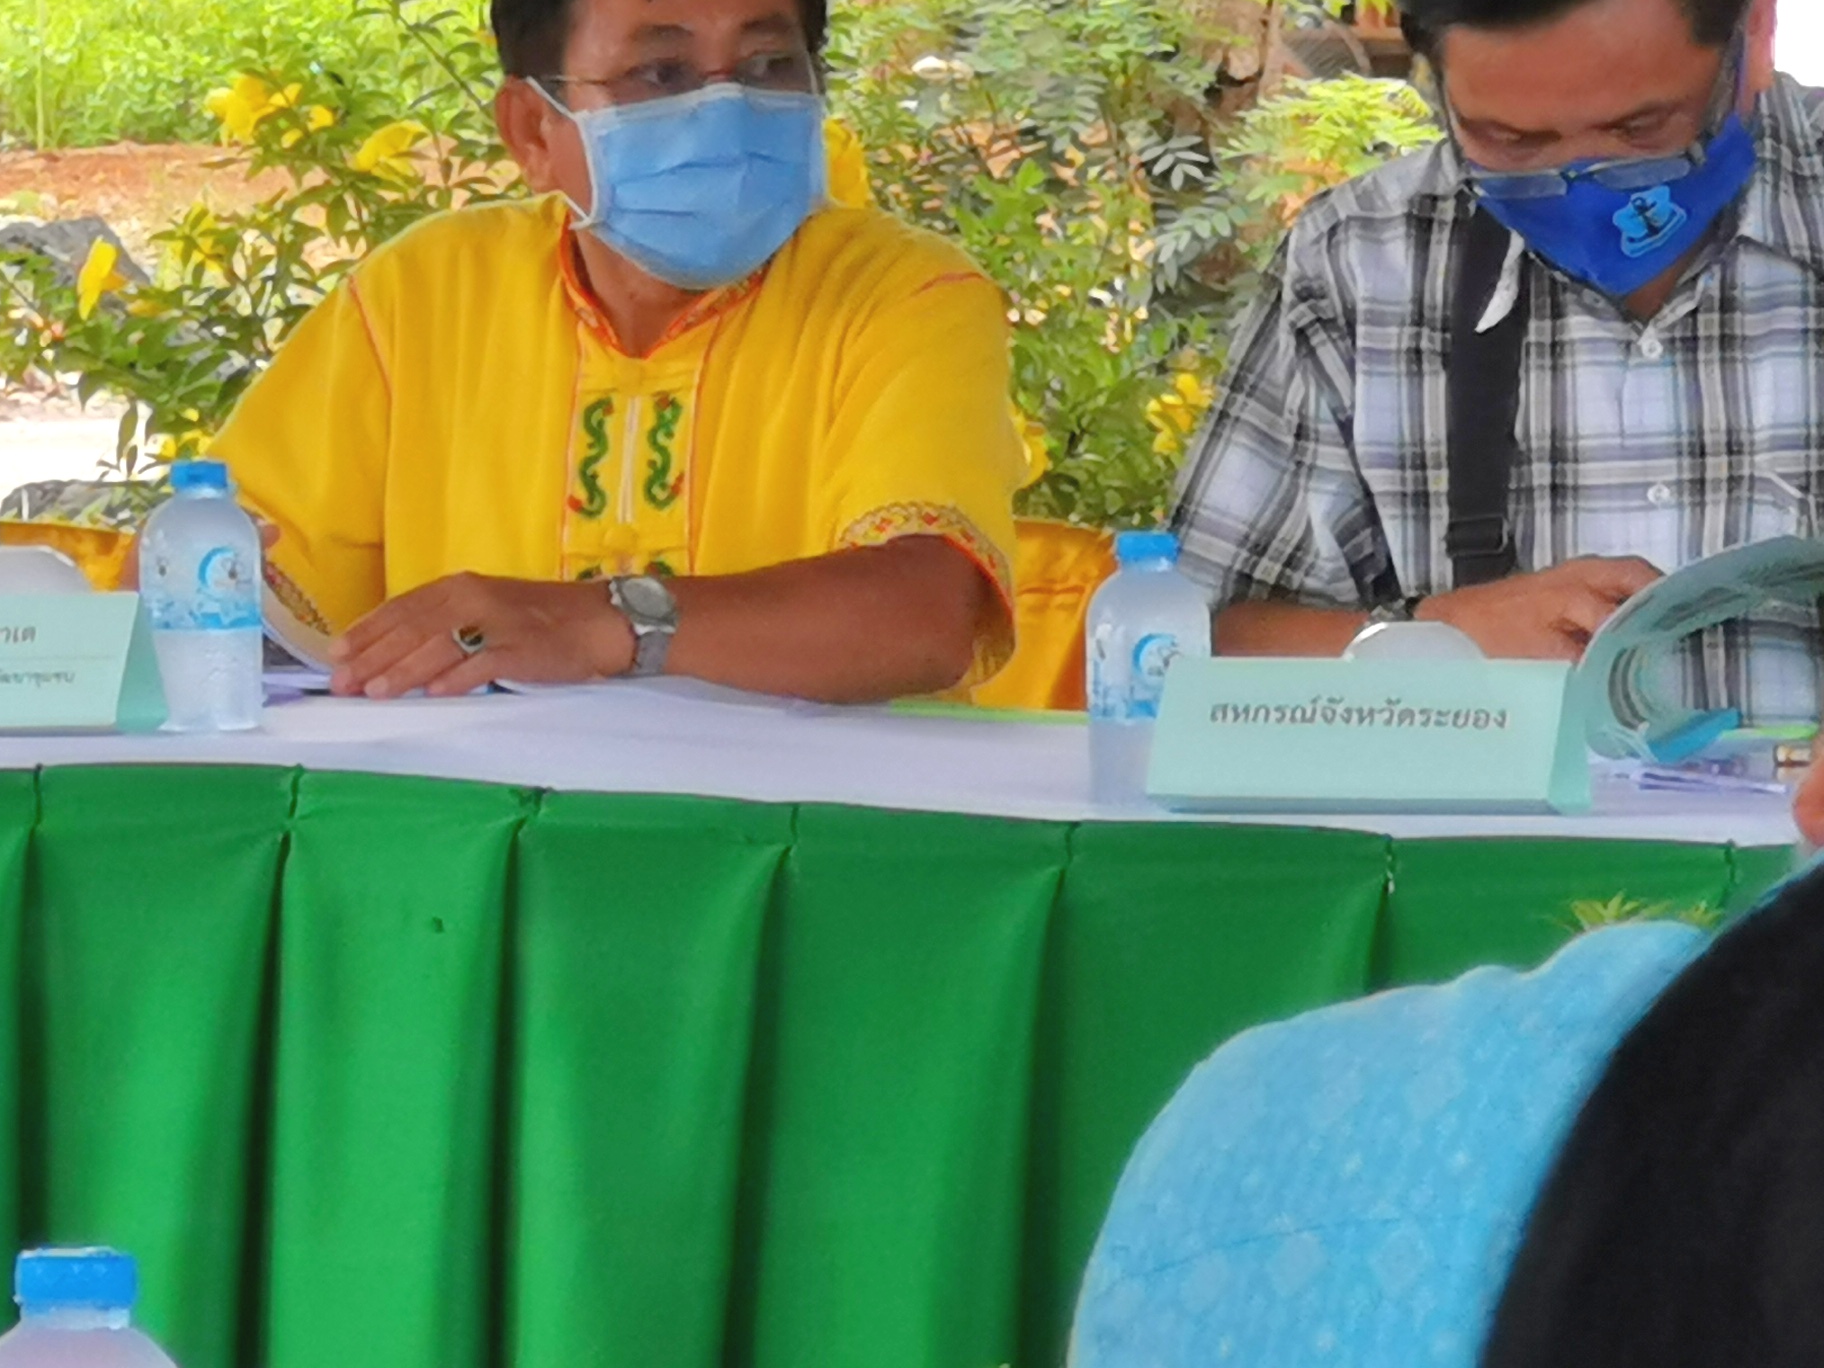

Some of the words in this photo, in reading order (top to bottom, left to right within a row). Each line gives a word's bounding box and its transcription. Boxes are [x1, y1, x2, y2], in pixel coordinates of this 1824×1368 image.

[1210, 693, 1509, 730] สหกรณ์จังหวัดระยอง
